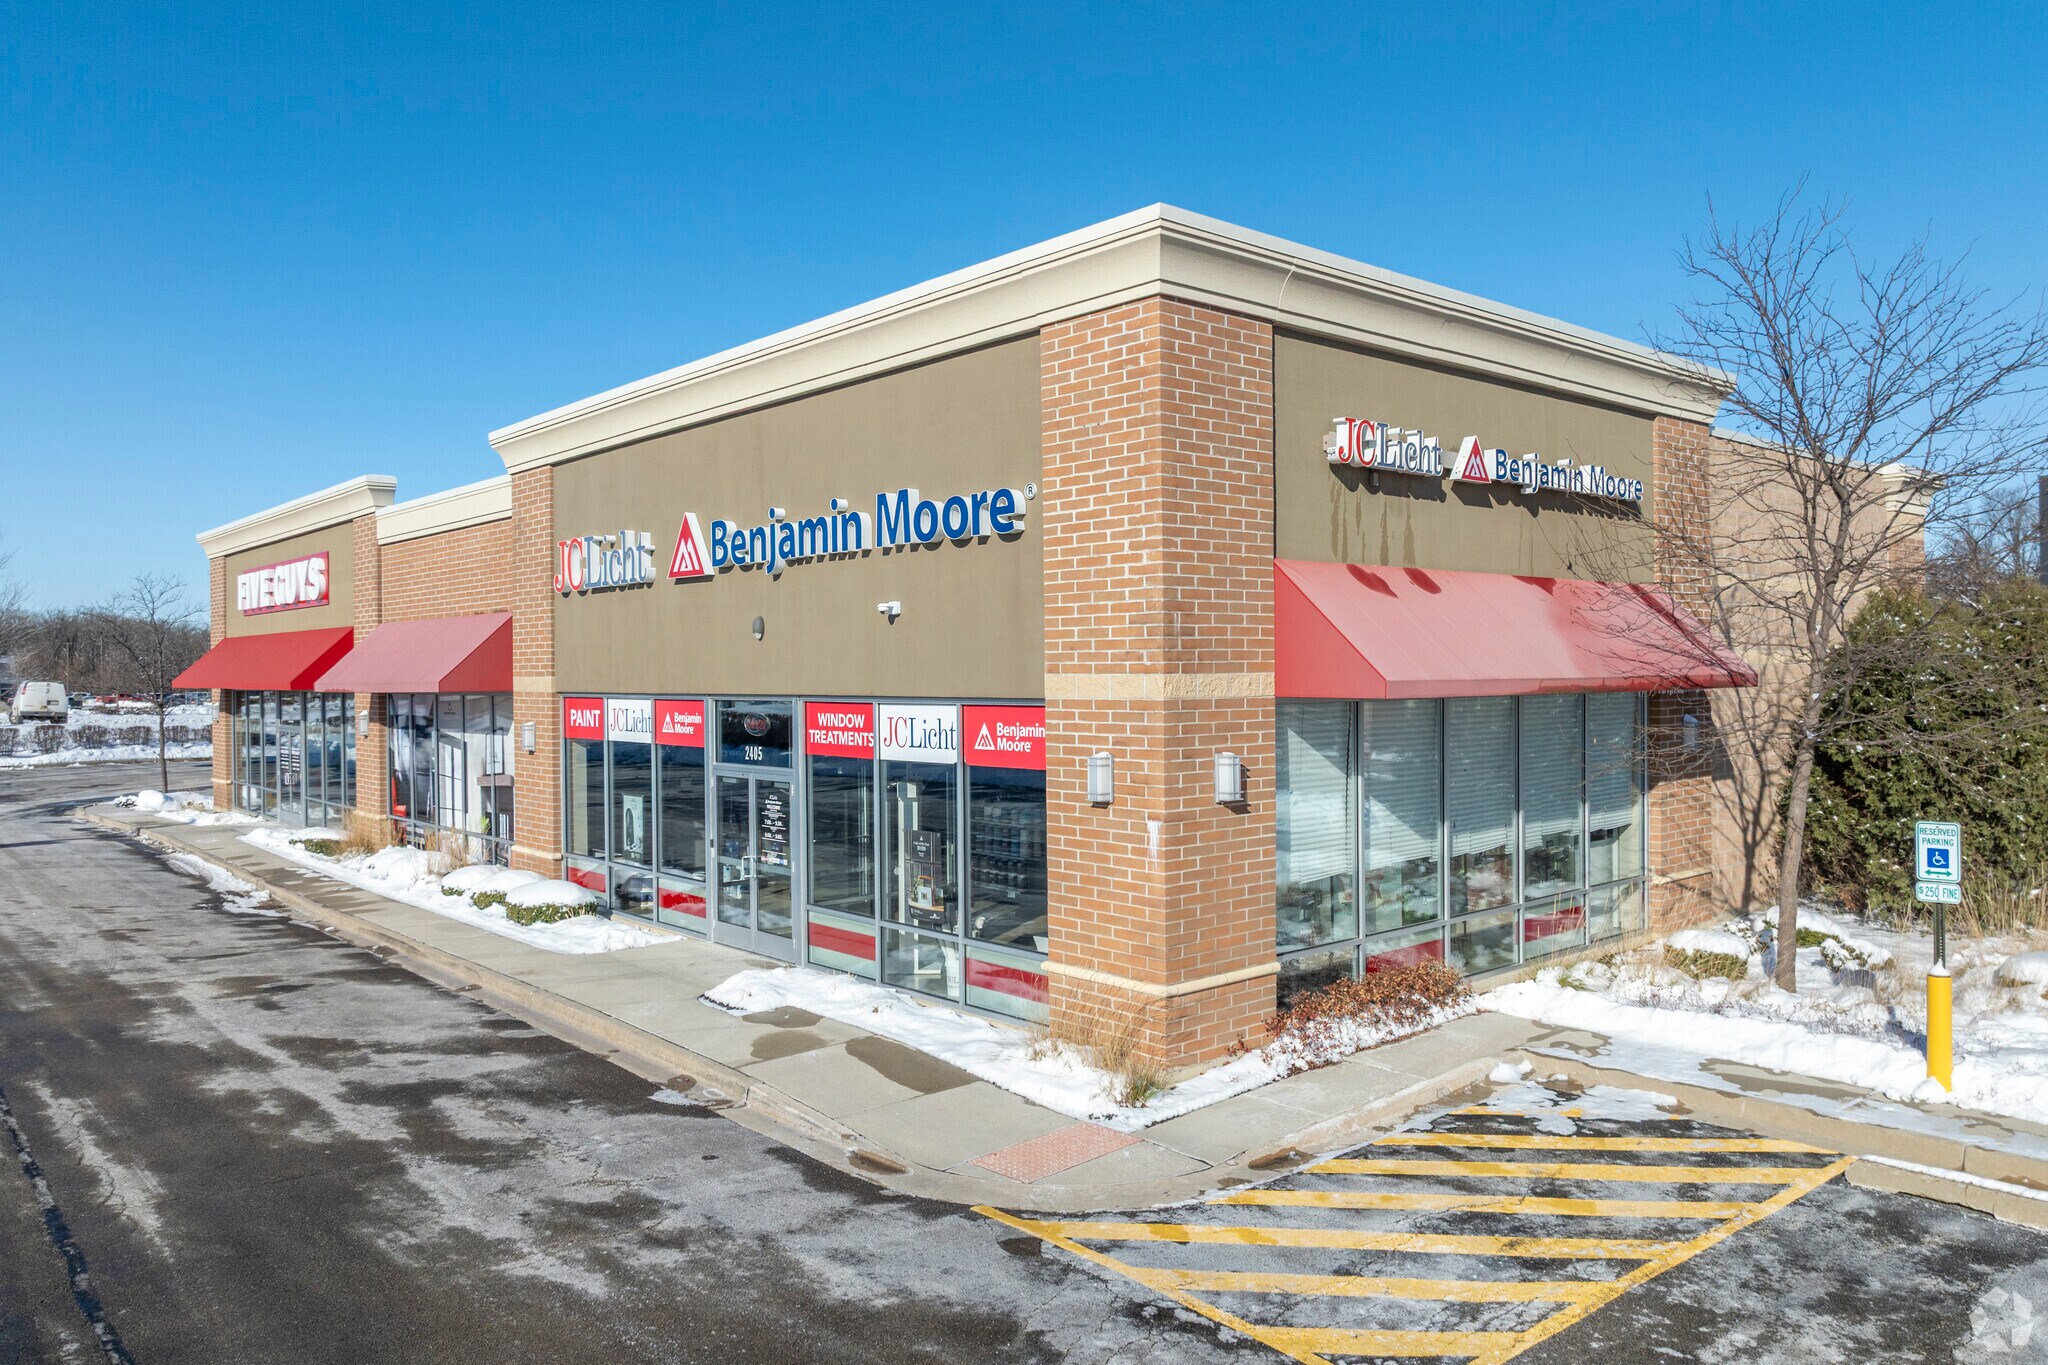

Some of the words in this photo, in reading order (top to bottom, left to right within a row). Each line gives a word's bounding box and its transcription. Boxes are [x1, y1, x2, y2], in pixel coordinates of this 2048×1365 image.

[1495, 448, 1584, 494] Benjamin
[1589, 464, 1644, 501] Moore
[710, 498, 866, 575] Benjamin
[237, 568, 275, 611] FIVE
[274, 557, 327, 606] GUYS
[570, 708, 601, 728] PAINT
[674, 711, 702, 725] Benjamin
[817, 712, 865, 728] WINDOW
[674, 723, 695, 735] Moore
[996, 722, 1046, 740] Benjamin
[808, 729, 874, 747] TREATMENTS
[996, 737, 1032, 753] Moore
[744, 745, 763, 761] 2405
[1919, 828, 1956, 837] RESERVED
[1922, 838, 1954, 847] PARKING
[1942, 887, 1959, 899] FINE
